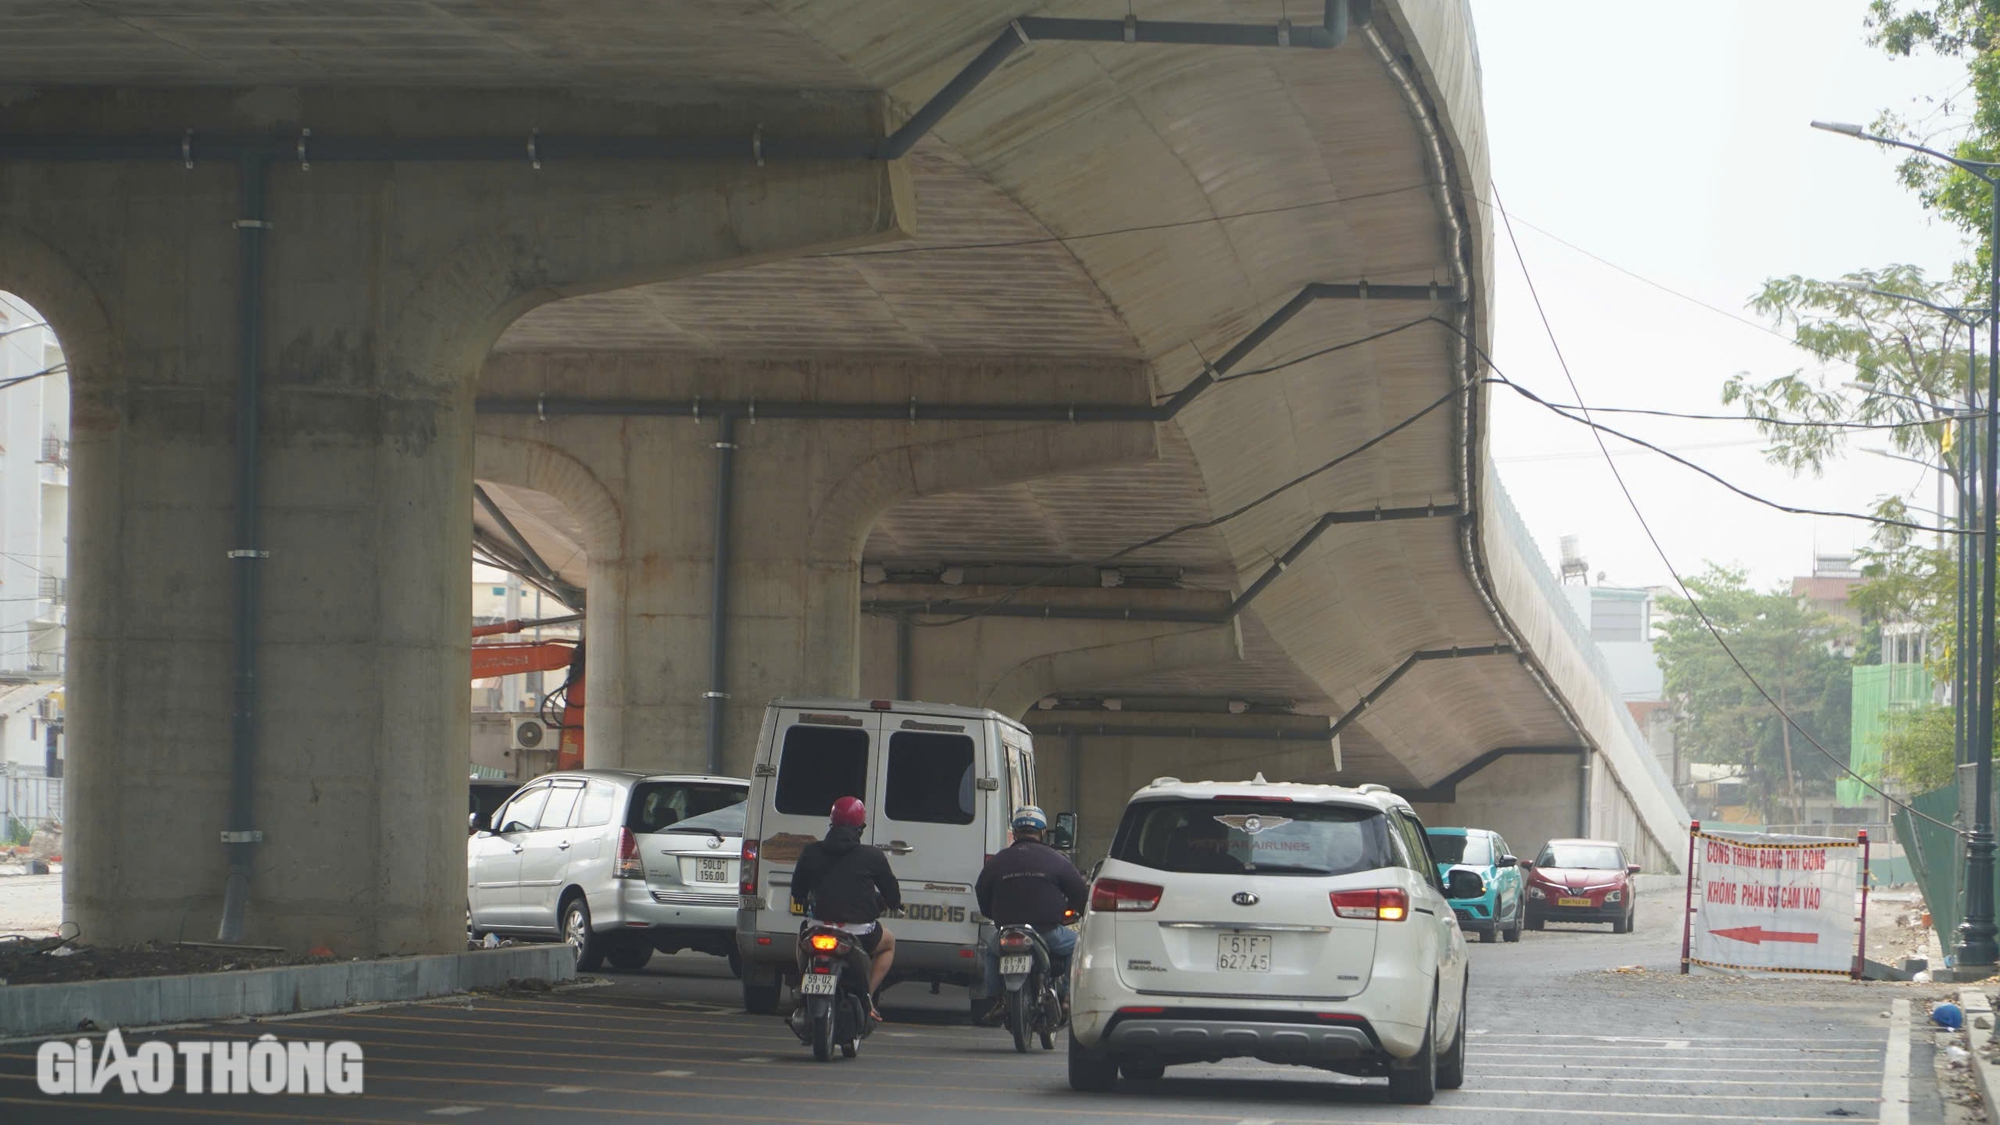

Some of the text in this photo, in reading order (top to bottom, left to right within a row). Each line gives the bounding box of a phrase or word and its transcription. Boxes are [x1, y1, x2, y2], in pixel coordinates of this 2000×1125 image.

[1250, 839, 1312, 851] AIRLINES
[1785, 849, 1800, 870] THI
[1235, 894, 1255, 904] KIA
[1706, 876, 1737, 905] KHÔNG
[1802, 882, 1821, 910] VÀO
[1231, 937, 1259, 953] 51F
[1220, 953, 1268, 970] 627.45
